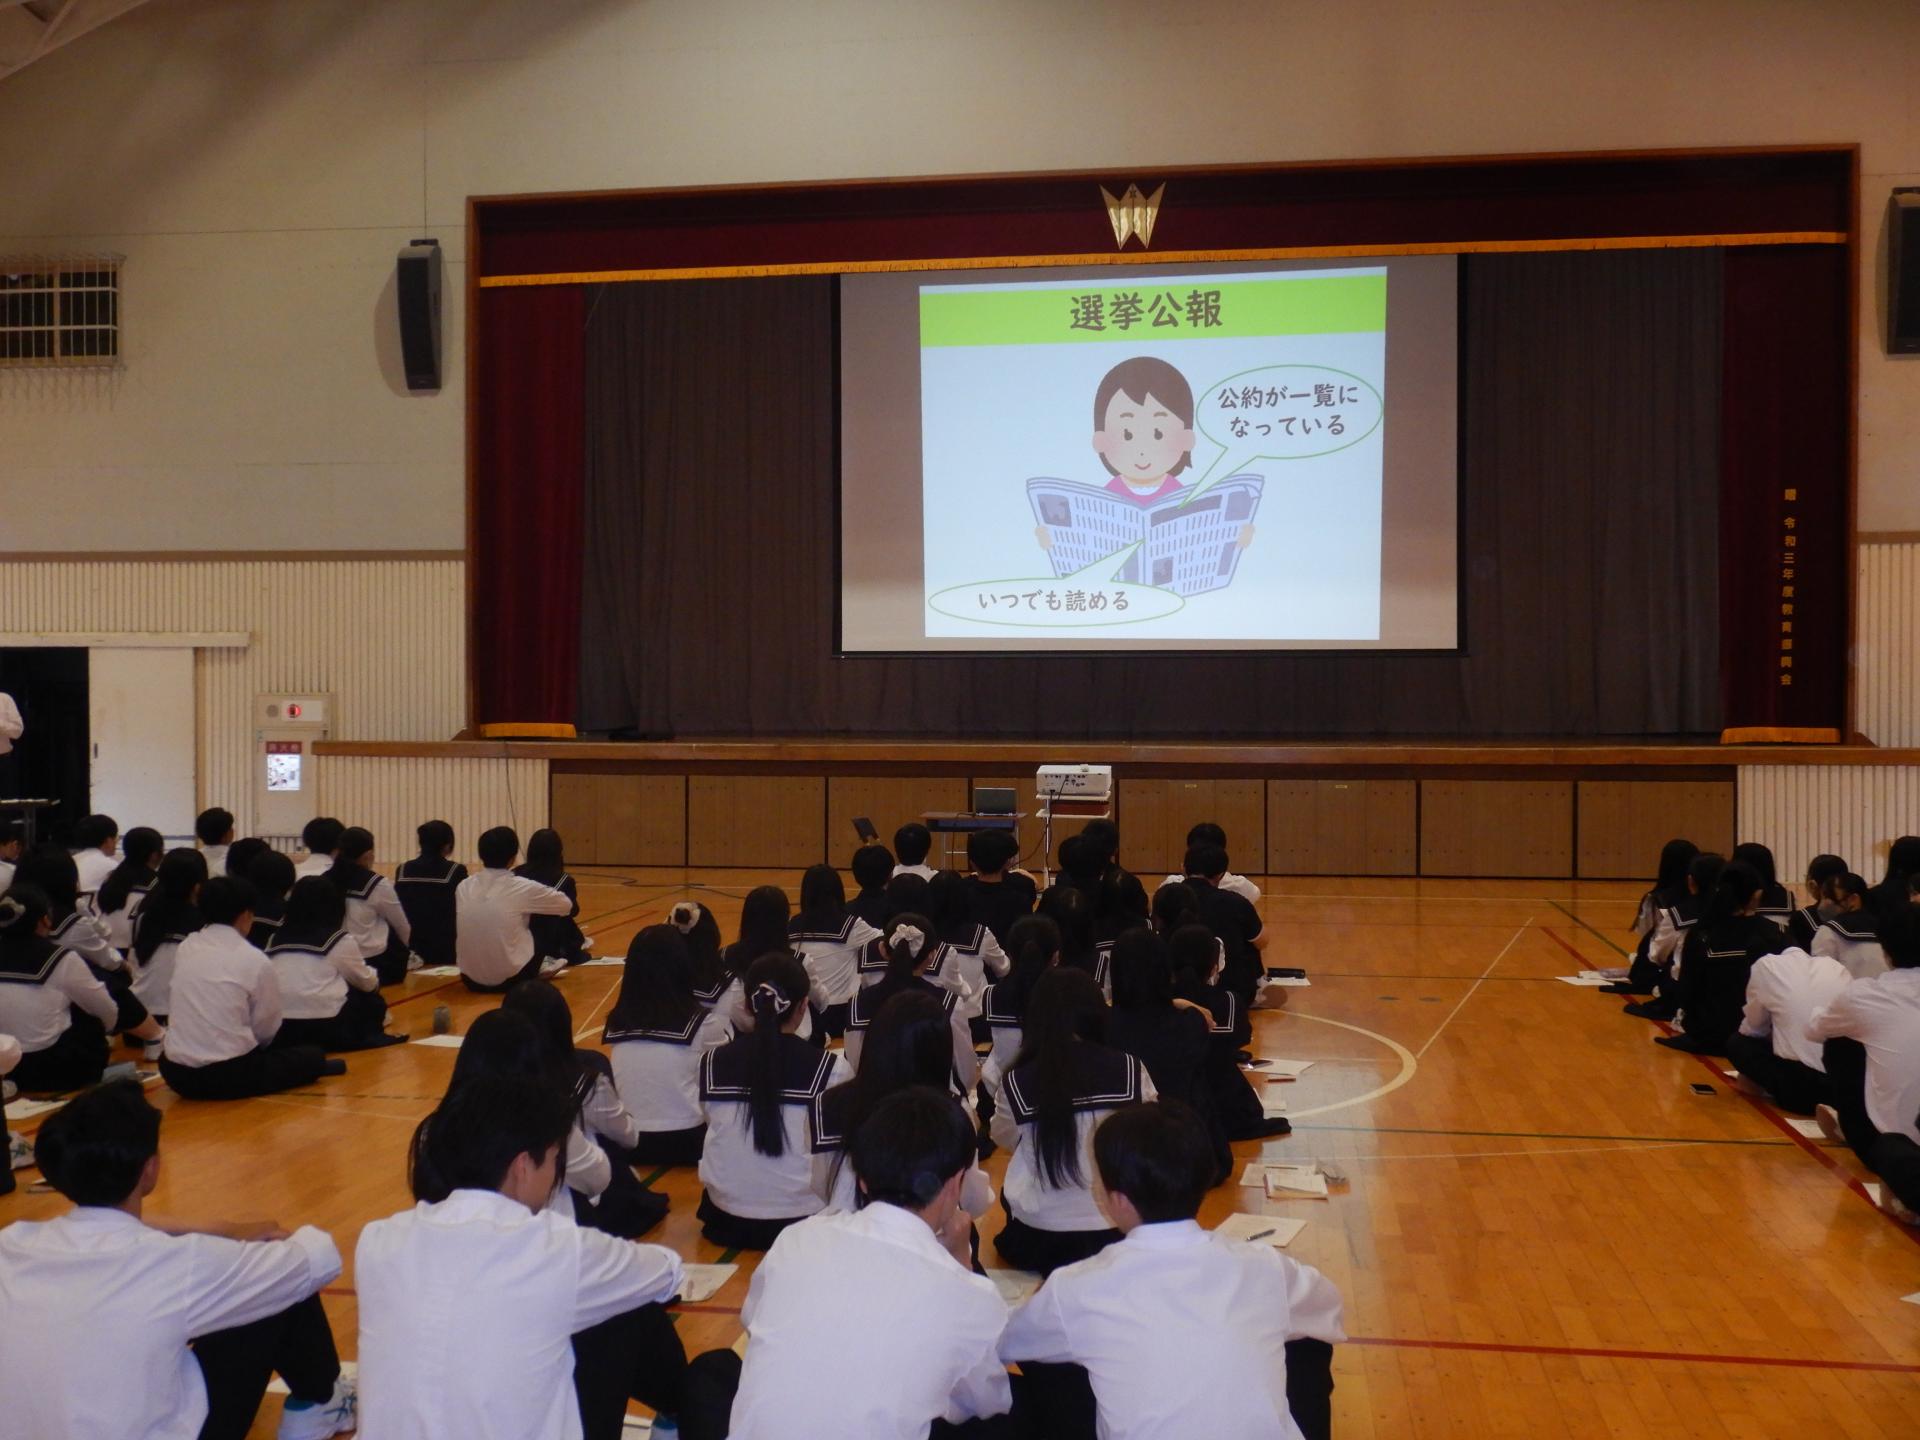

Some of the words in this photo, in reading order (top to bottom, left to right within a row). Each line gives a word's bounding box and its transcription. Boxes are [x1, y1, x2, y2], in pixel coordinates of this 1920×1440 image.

[1070, 289, 1223, 331] 選挙公報
[1217, 383, 1359, 409] 公約が一覧に
[1230, 414, 1345, 437] なっている
[978, 589, 1129, 611] いつでも読める
